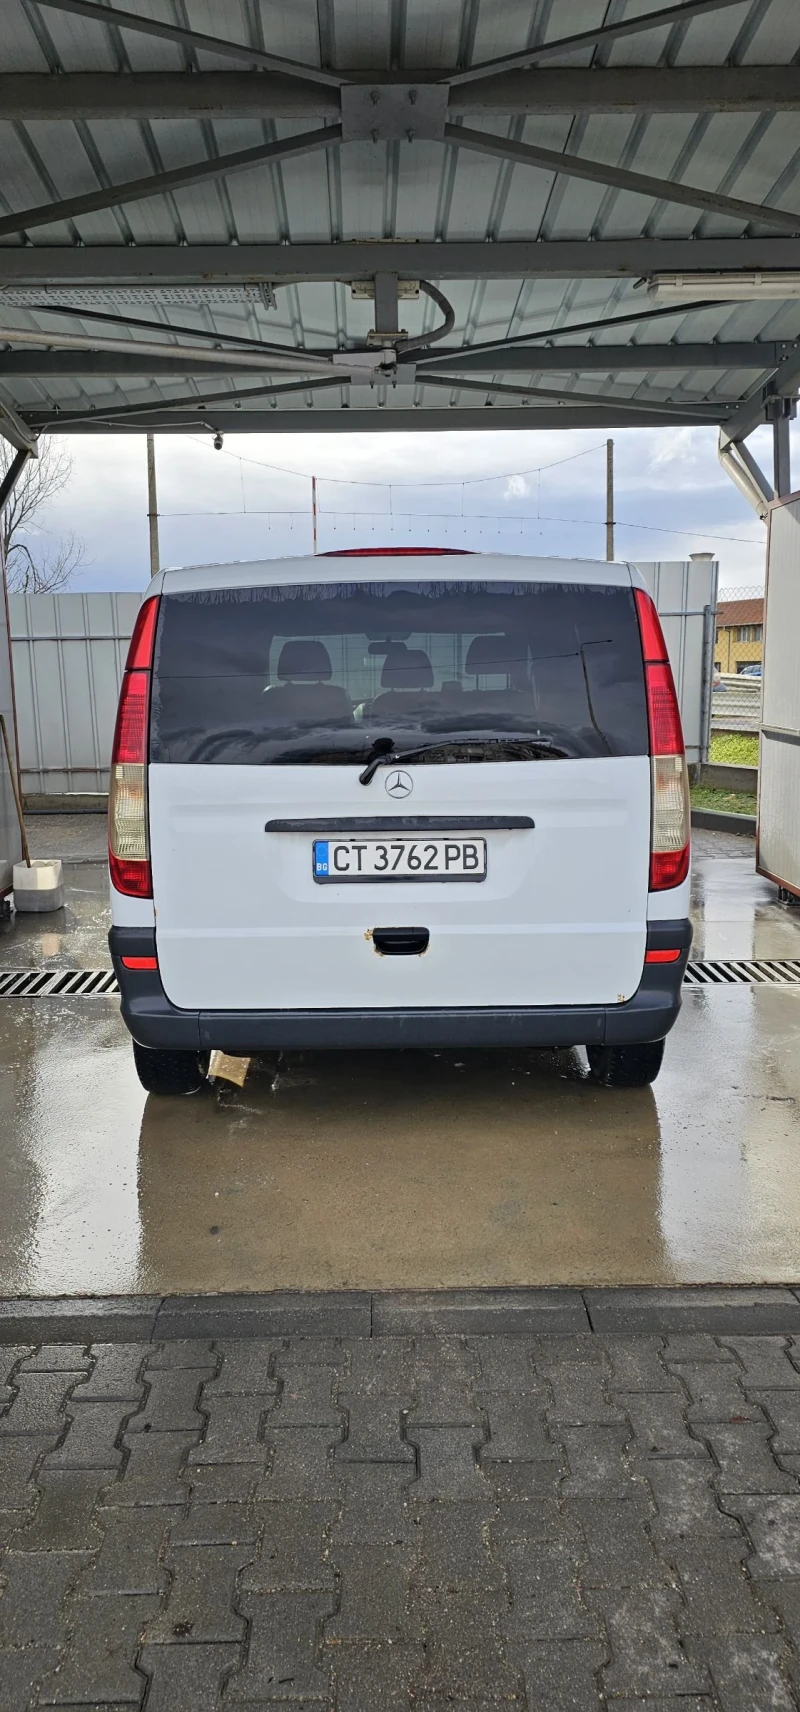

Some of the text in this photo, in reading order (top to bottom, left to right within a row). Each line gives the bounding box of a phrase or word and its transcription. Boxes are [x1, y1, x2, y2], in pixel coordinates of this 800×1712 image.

[316, 862, 328, 871] BG
[333, 844, 479, 872] CT 3762 PB
